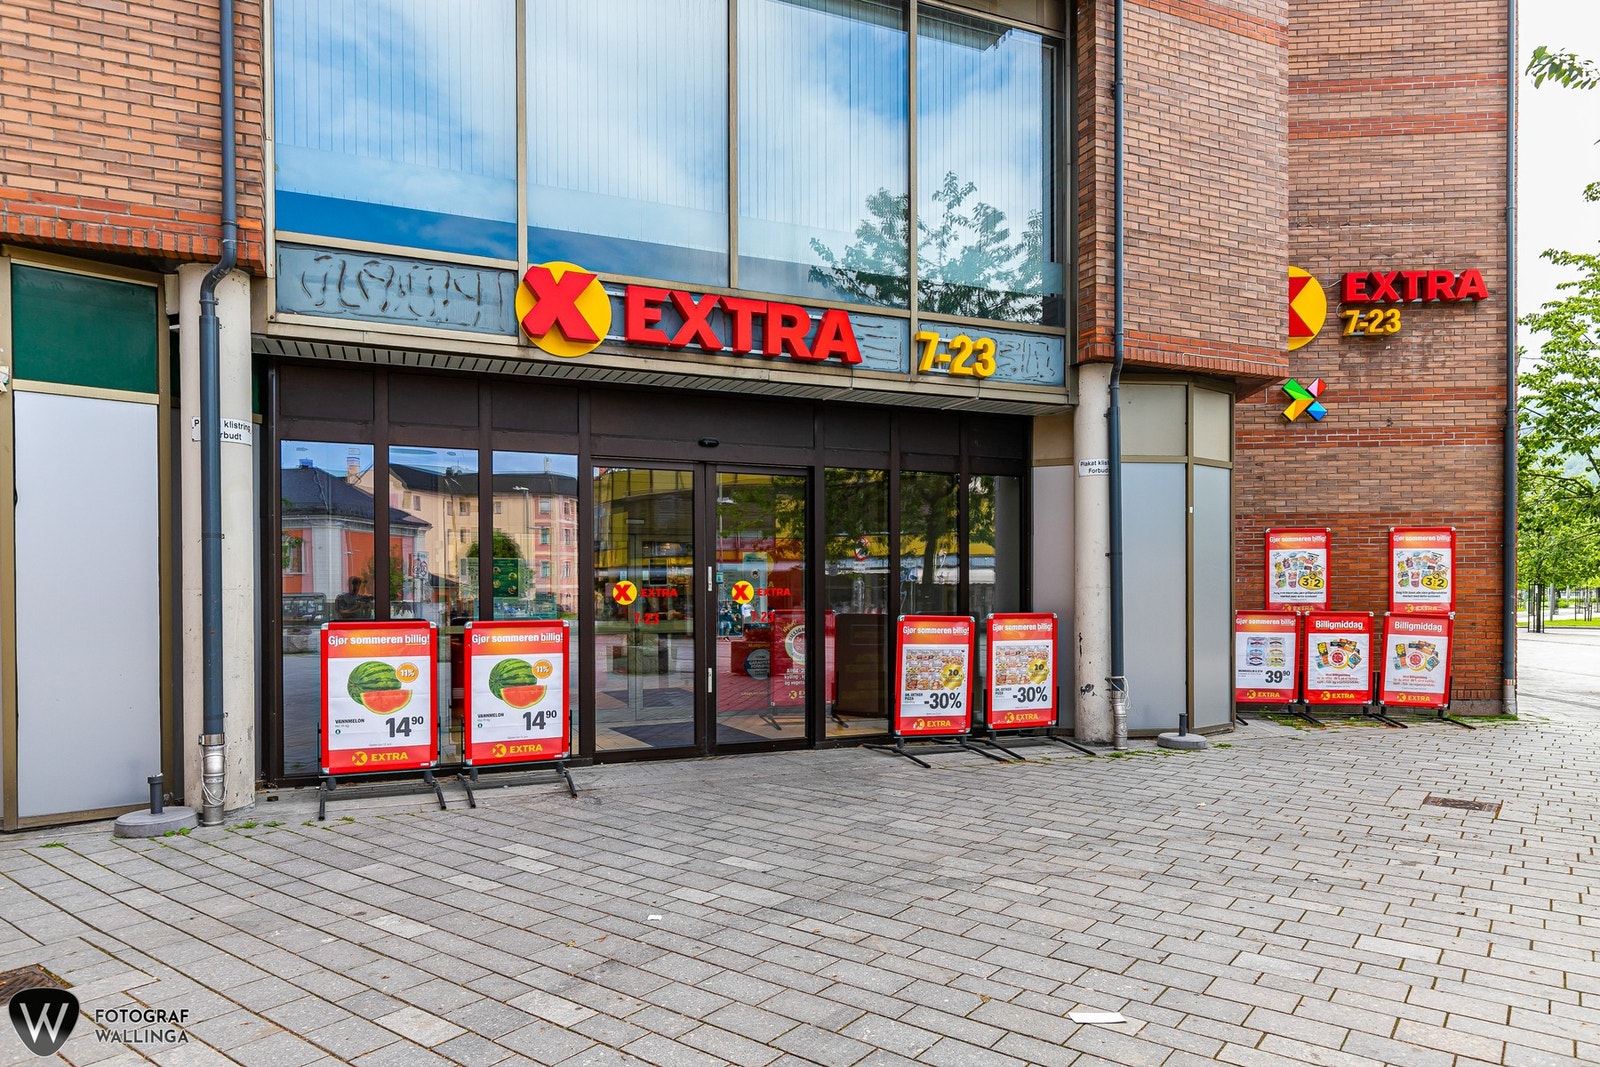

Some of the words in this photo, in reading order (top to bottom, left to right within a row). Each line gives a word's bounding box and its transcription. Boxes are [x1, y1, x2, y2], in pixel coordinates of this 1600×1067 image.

[1341, 269, 1489, 304] EXTRA
[624, 284, 863, 365] EXTRA
[1341, 308, 1402, 336] 7-23
[914, 330, 997, 379] 7-23
[219, 432, 242, 440] rbudt
[641, 588, 678, 598] EXTRA
[757, 588, 791, 596] EXTRA
[1315, 620, 1363, 630] Billigmiddag
[1394, 621, 1442, 632] Billigmiddag
[328, 635, 348, 647] Gjør
[350, 636, 403, 645] sommeren
[405, 634, 430, 645] billig!
[472, 634, 490, 645] Gjør
[491, 634, 539, 643] sommeren
[540, 632, 563, 643] billig!
[400, 669, 415, 677] 11%
[1012, 686, 1048, 703] -30%
[924, 692, 962, 709] -30%
[1016, 713, 1038, 721] EXTRA
[927, 720, 951, 728] EXTRA
[509, 744, 543, 754] EXTRA
[371, 751, 409, 762] EXTRA
